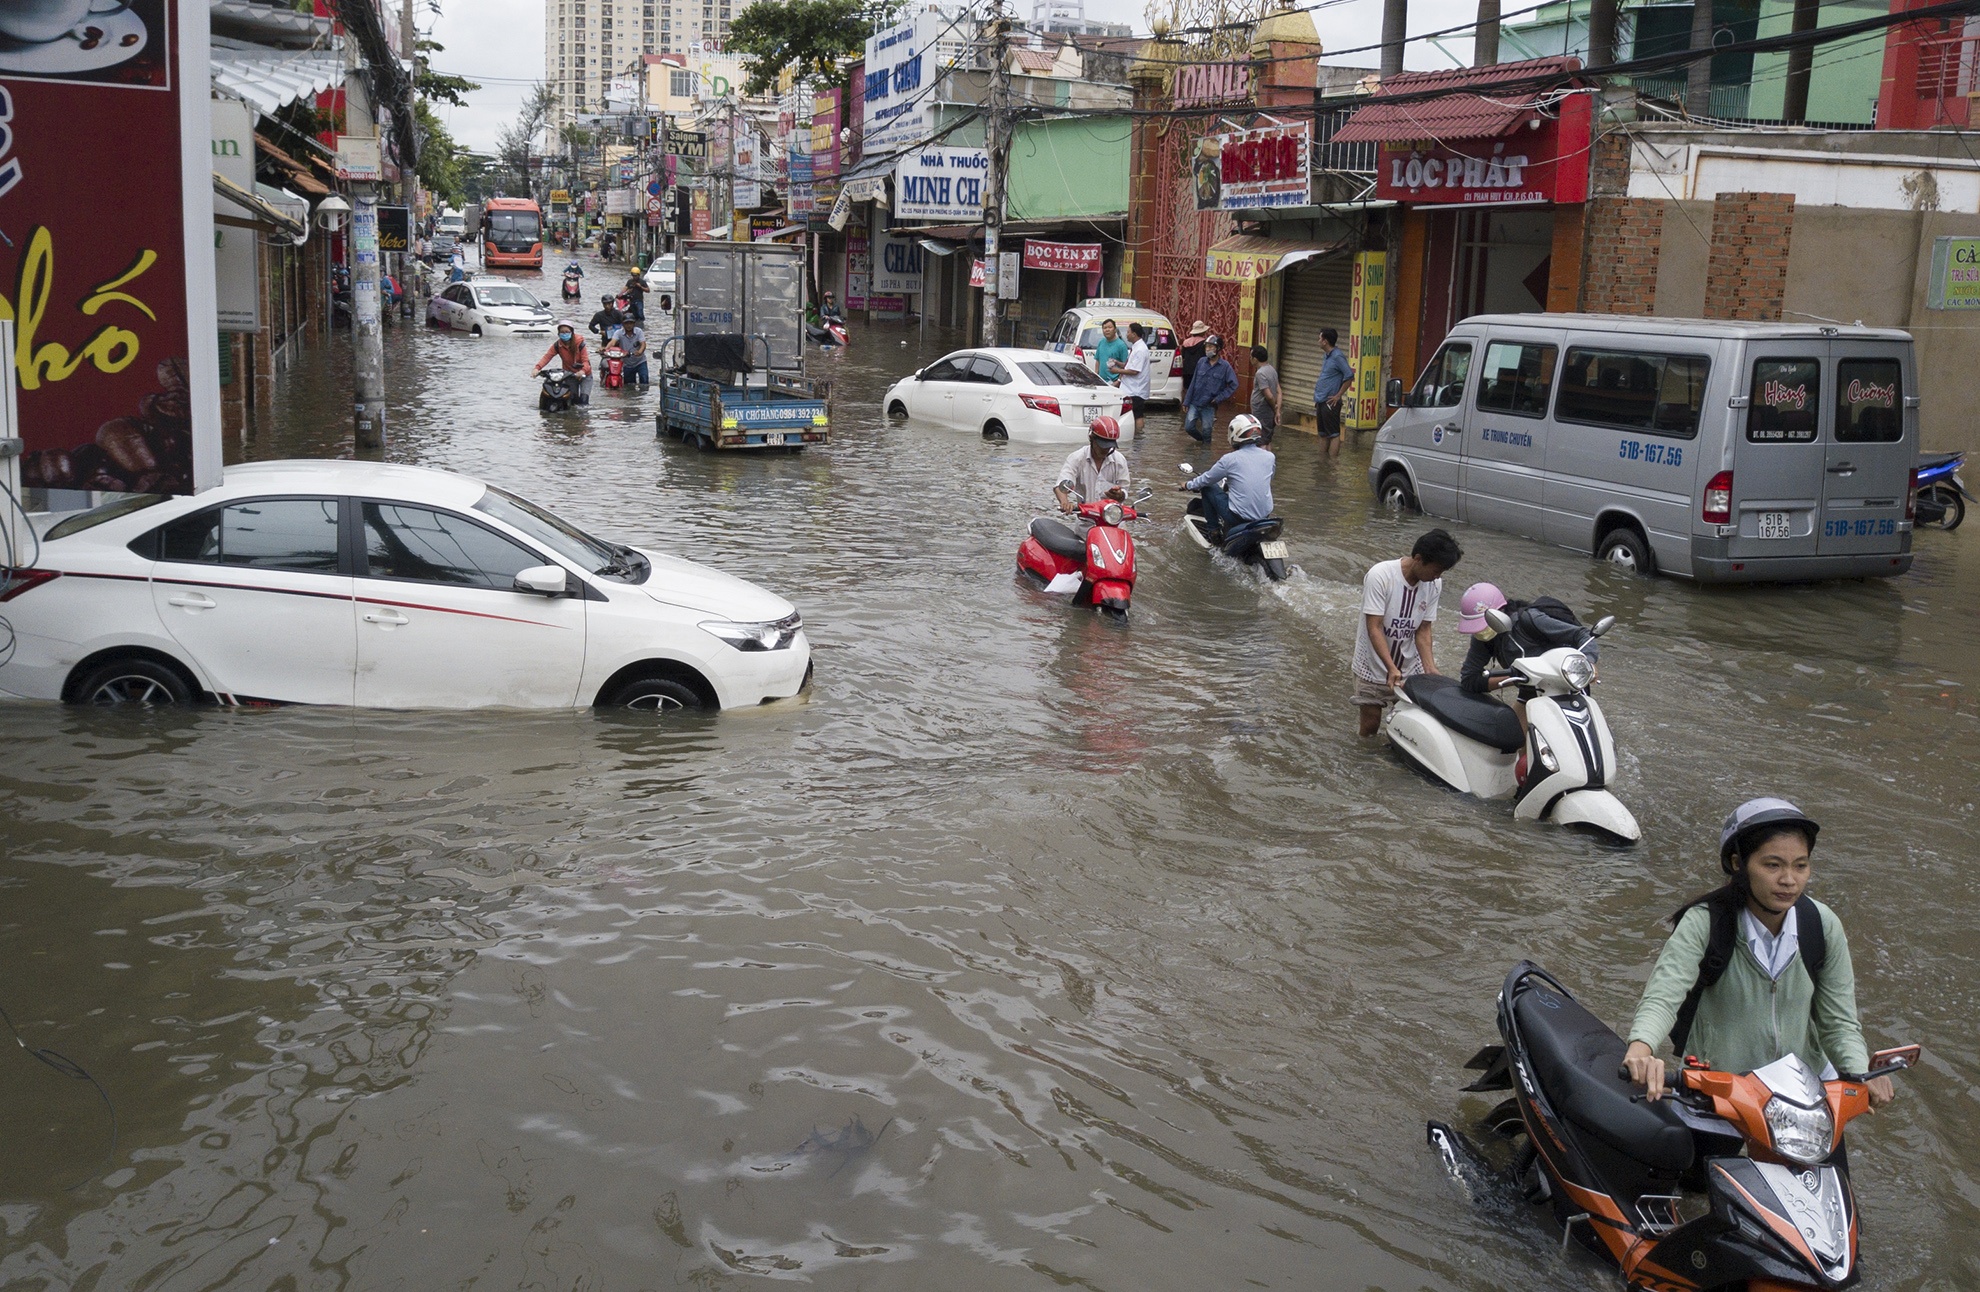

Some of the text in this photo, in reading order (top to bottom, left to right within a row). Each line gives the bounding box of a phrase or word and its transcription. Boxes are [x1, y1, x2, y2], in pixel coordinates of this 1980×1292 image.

[669, 132, 699, 142] Saigon
[665, 141, 704, 157] GYM
[920, 152, 988, 169] NHÀ THUỐC
[1390, 142, 1529, 194] LỘC PHÁT
[902, 176, 951, 205] MINH
[1026, 245, 1099, 261] BỌC YÊN XE
[1956, 245, 1977, 264] CÀ
[1215, 255, 1233, 276] BÒ
[1234, 257, 1254, 278] NÉ
[1368, 265, 1384, 287] SINH
[1370, 292, 1380, 322] TỐ
[1364, 366, 1376, 392] GIÁ
[1764, 379, 1807, 410] Hùng
[1847, 378, 1896, 408] Cường
[1361, 398, 1379, 421] 15K
[1481, 428, 1489, 441] XE
[1490, 429, 1508, 444] TRUNG
[1619, 439, 1684, 467] 51B-167.56
[1765, 513, 1783, 526] 51B
[1824, 518, 1895, 537] 51B-167.56
[1760, 526, 1790, 538] 167.56
[1391, 618, 1416, 629] REAL
